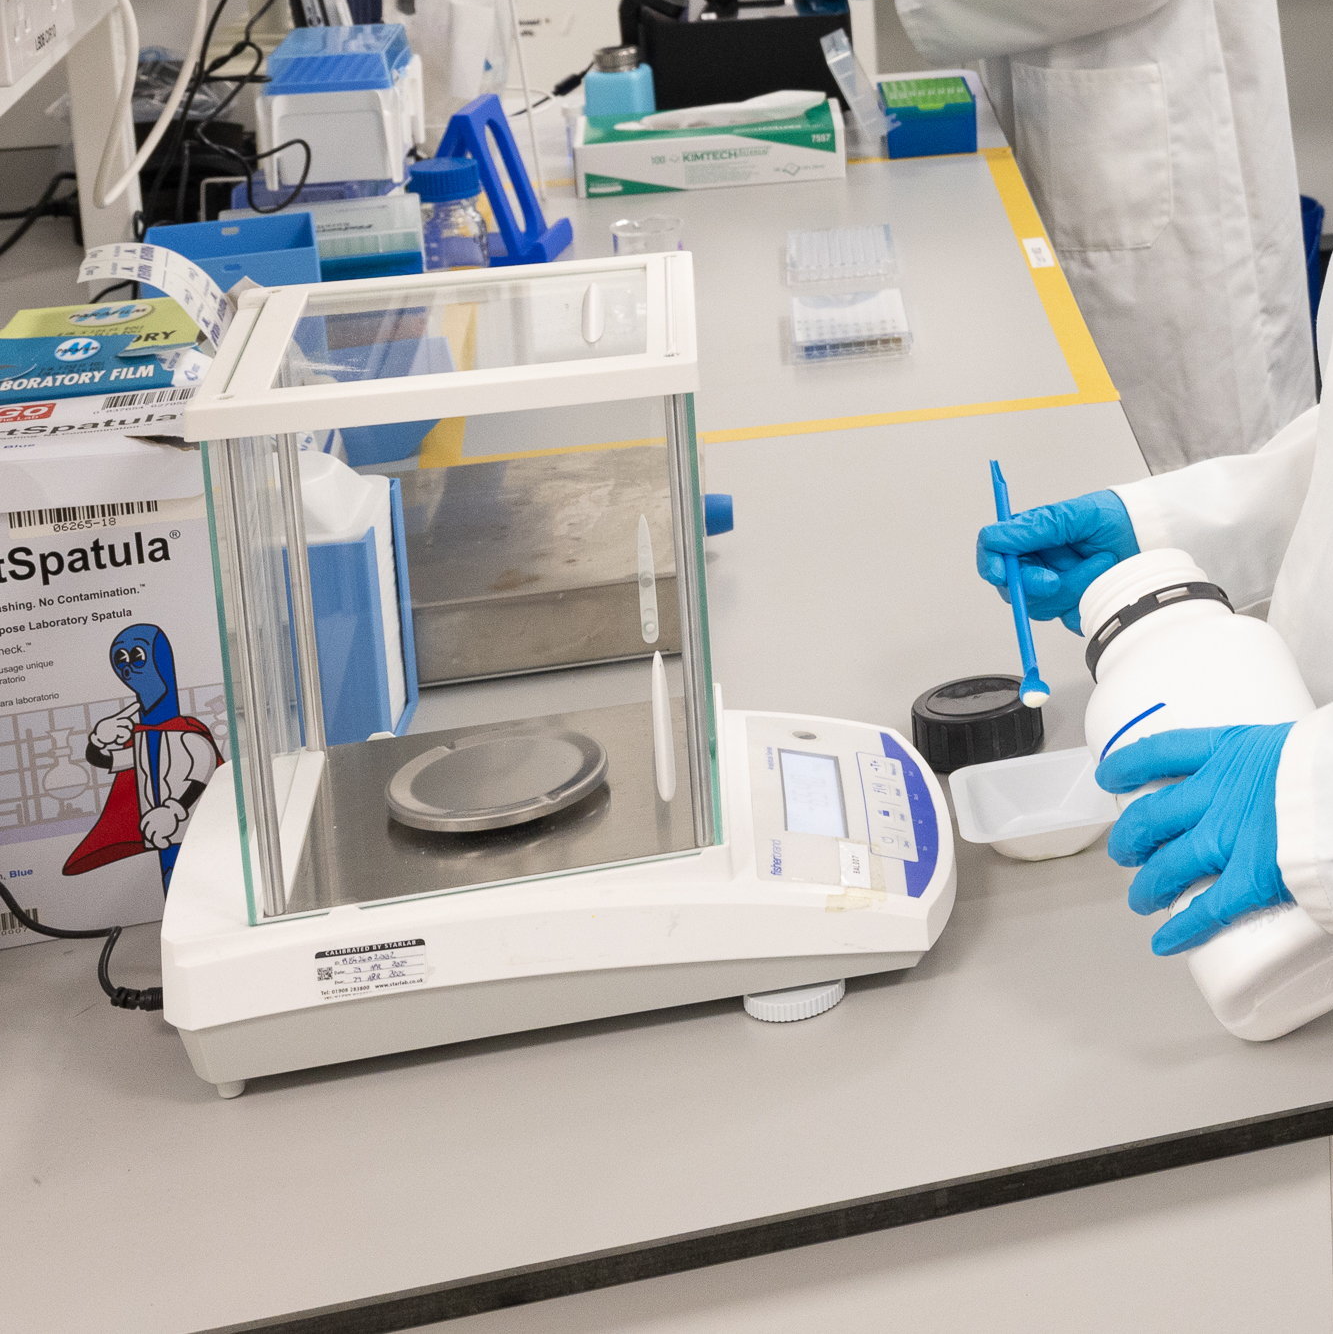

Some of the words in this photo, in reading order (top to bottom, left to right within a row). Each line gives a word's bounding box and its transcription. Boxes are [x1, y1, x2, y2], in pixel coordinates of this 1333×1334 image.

[109, 364, 155, 381] FILM
[53, 517, 117, 533] 06265-18
[39, 597, 55, 608] No
[29, 615, 89, 631] Laboratory
[91, 608, 133, 623] Spatula
[26, 659, 54, 671] unique
[15, 692, 60, 706] laboratorio
[770, 838, 783, 877] fisherbrand
[9, 869, 33, 878] Blue
[324, 945, 370, 957] CALIBRATED
[372, 943, 382, 951] BY
[384, 939, 417, 950] STARLAB
